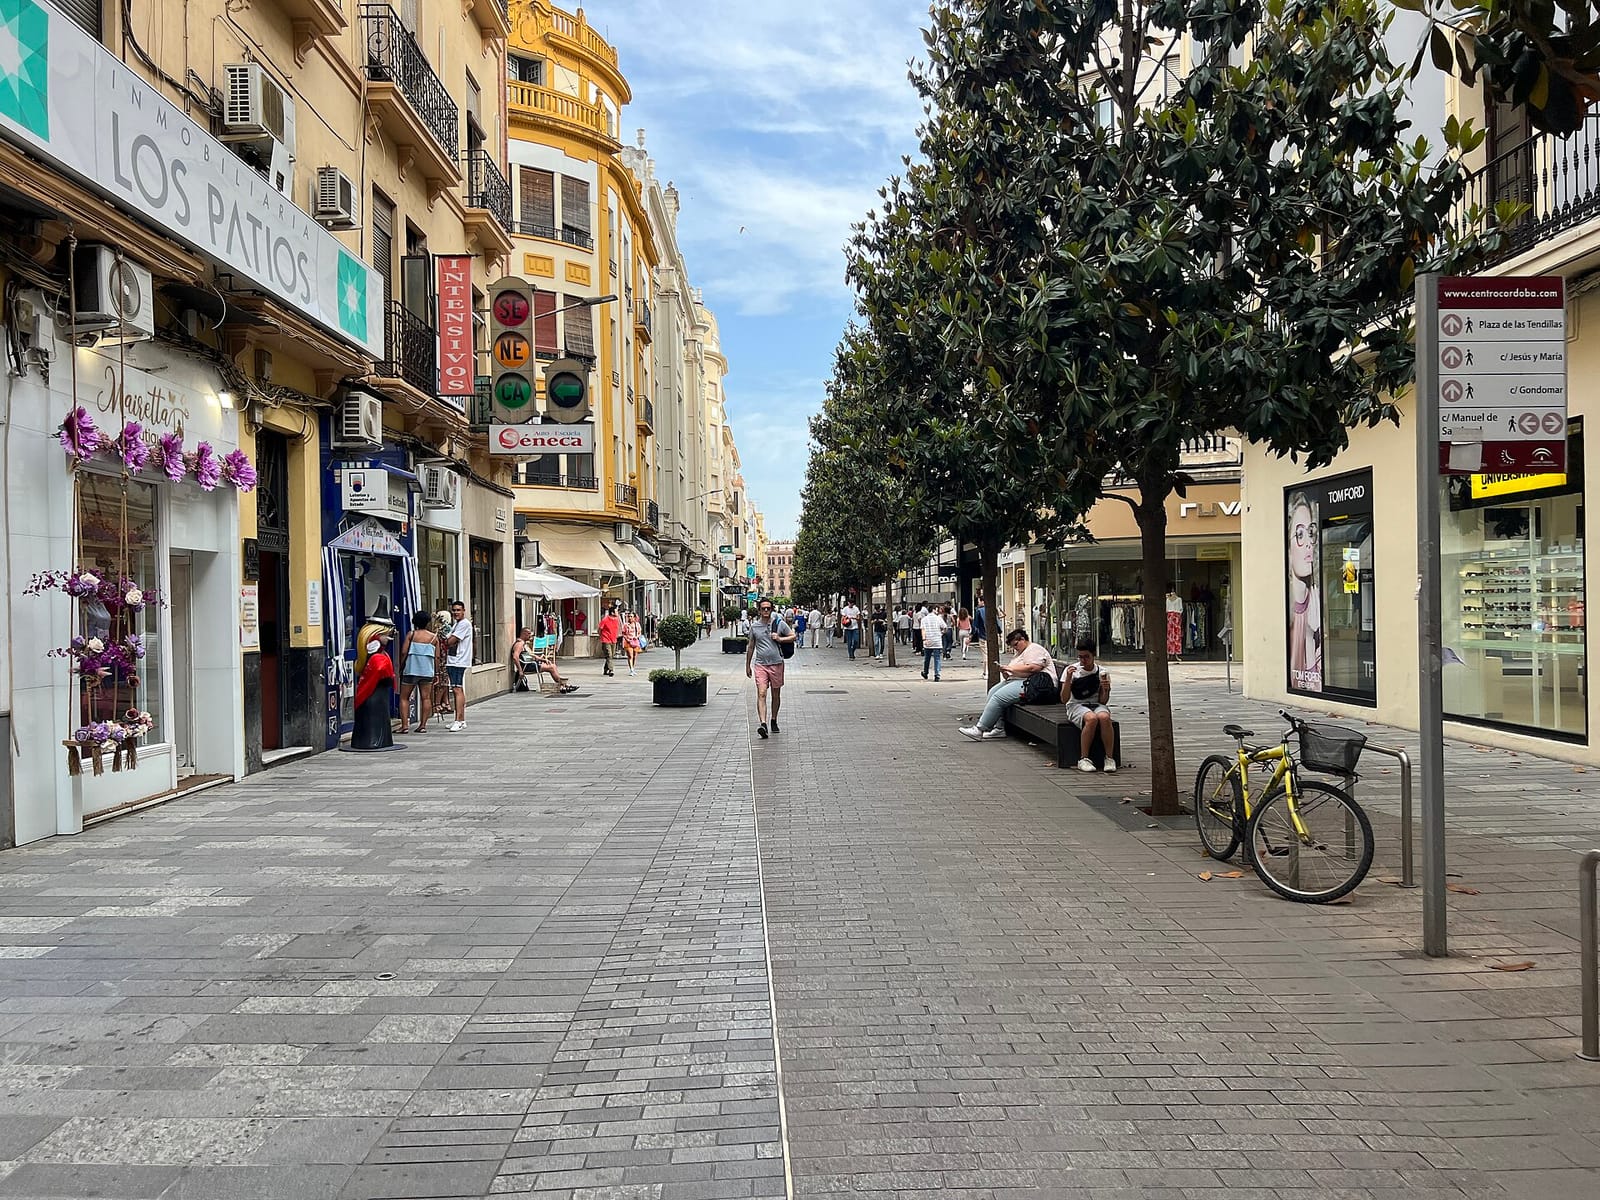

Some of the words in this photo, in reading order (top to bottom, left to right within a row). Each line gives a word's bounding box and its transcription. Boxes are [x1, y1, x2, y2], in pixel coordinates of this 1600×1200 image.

[112, 70, 309, 241] INMOBILIARIA
[111, 111, 190, 227] LOS
[208, 183, 311, 305] PATIOS
[1444, 289, 1558, 298] www.centrocordoba.com
[498, 298, 523, 320] SE
[443, 259, 468, 391] INTENSIVOS
[1479, 321, 1501, 329] Plaza
[1502, 321, 1513, 329] de
[1514, 321, 1526, 329] las
[1528, 321, 1563, 329] Tendillas
[500, 340, 524, 361] NE
[1500, 353, 1509, 361] c/
[1509, 352, 1532, 361] Jesús
[1533, 354, 1538, 362] y
[1540, 352, 1563, 361] María
[501, 382, 524, 402] CA
[1510, 386, 1518, 394] c/
[1519, 386, 1563, 394] Gondomar
[1442, 414, 1450, 422] c/
[1452, 413, 1485, 422] Manuel
[1487, 413, 1498, 422] de
[498, 427, 583, 449] Séneca
[1328, 490, 1344, 504] TOM
[1344, 485, 1365, 500] FORD
